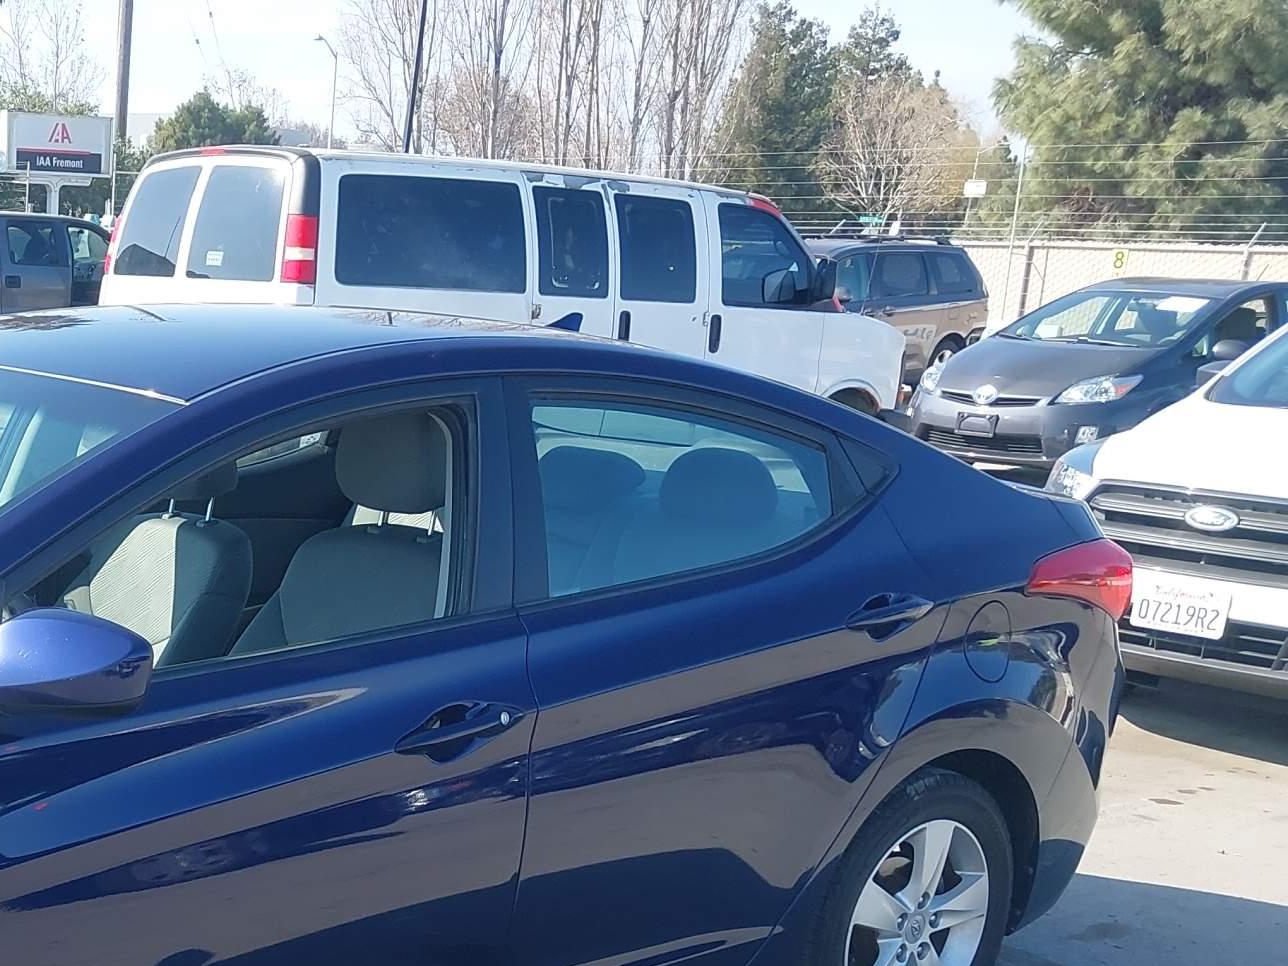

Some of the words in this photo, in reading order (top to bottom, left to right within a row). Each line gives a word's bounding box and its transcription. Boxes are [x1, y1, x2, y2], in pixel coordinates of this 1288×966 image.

[36, 155, 51, 167] IAA
[52, 156, 83, 169] Fremont
[1113, 251, 1125, 269] 8
[1138, 598, 1220, 631] 07219R2
